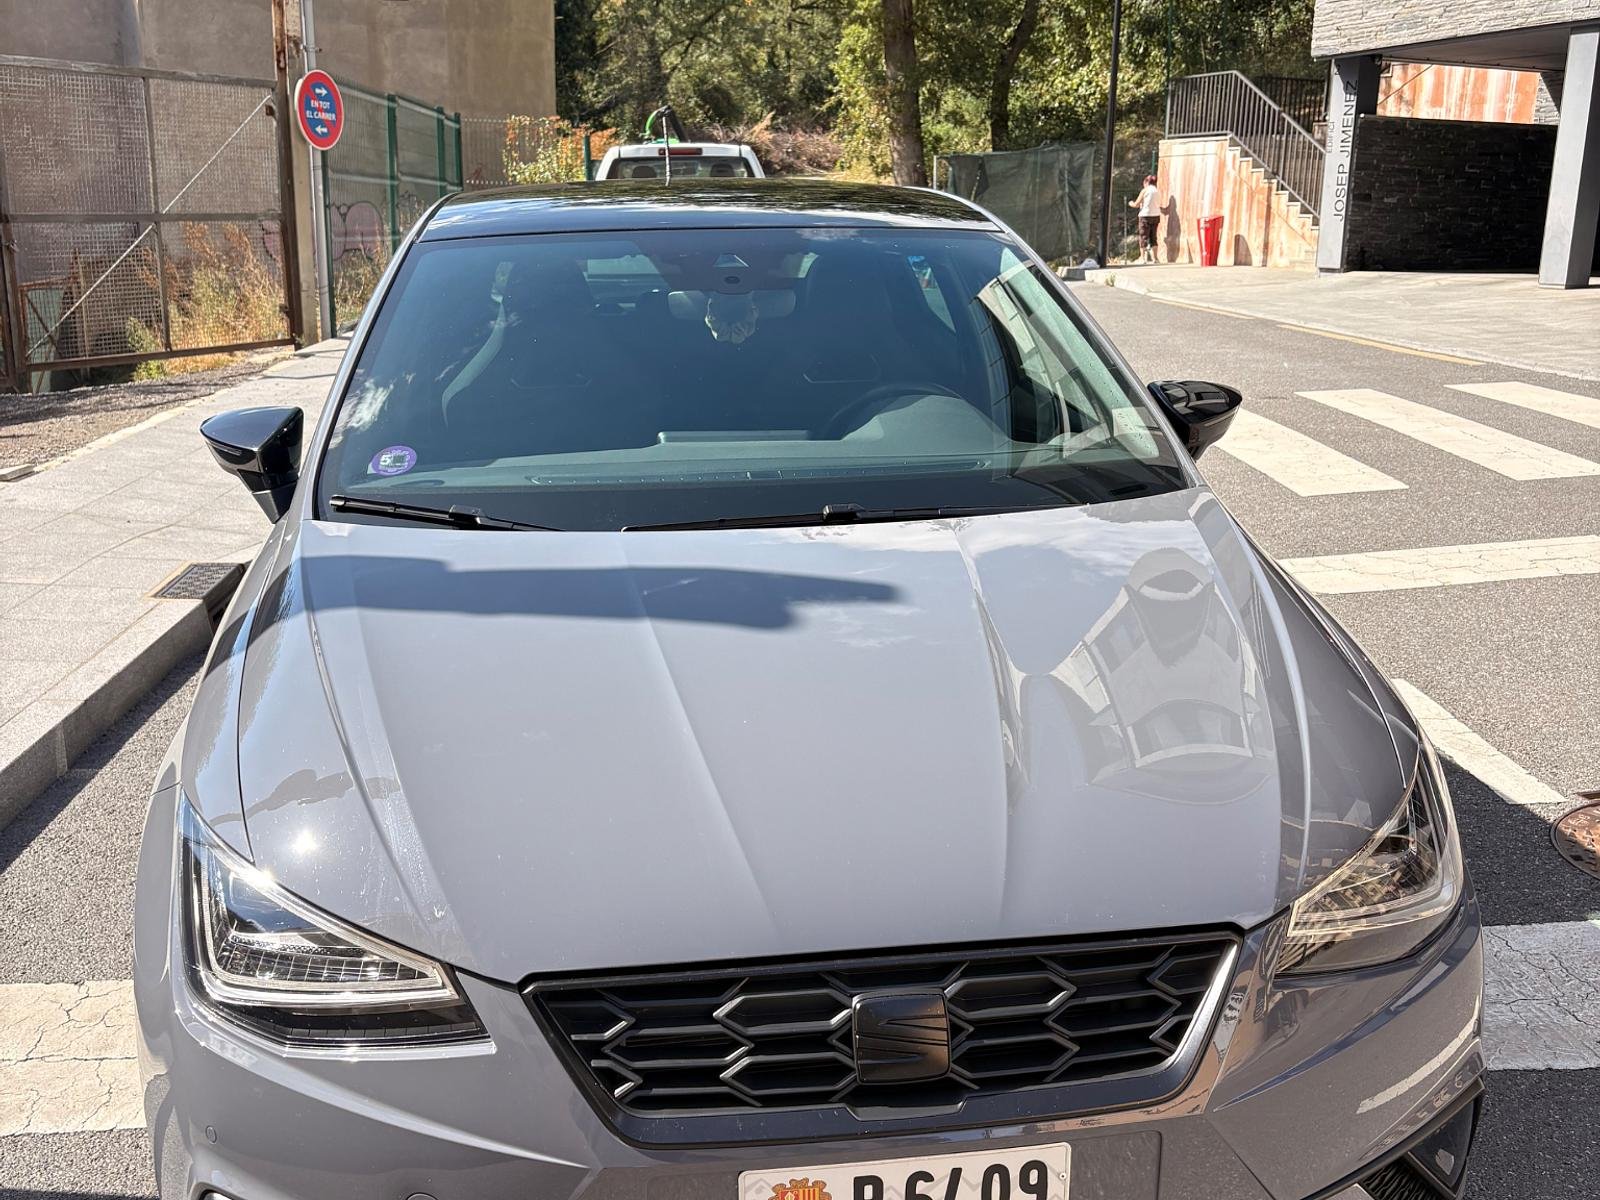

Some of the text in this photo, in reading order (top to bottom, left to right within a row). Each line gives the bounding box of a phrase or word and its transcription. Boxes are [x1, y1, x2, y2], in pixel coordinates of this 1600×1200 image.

[306, 110, 313, 119] EL
[1333, 79, 1358, 222] JOSEP JIMENEZ
